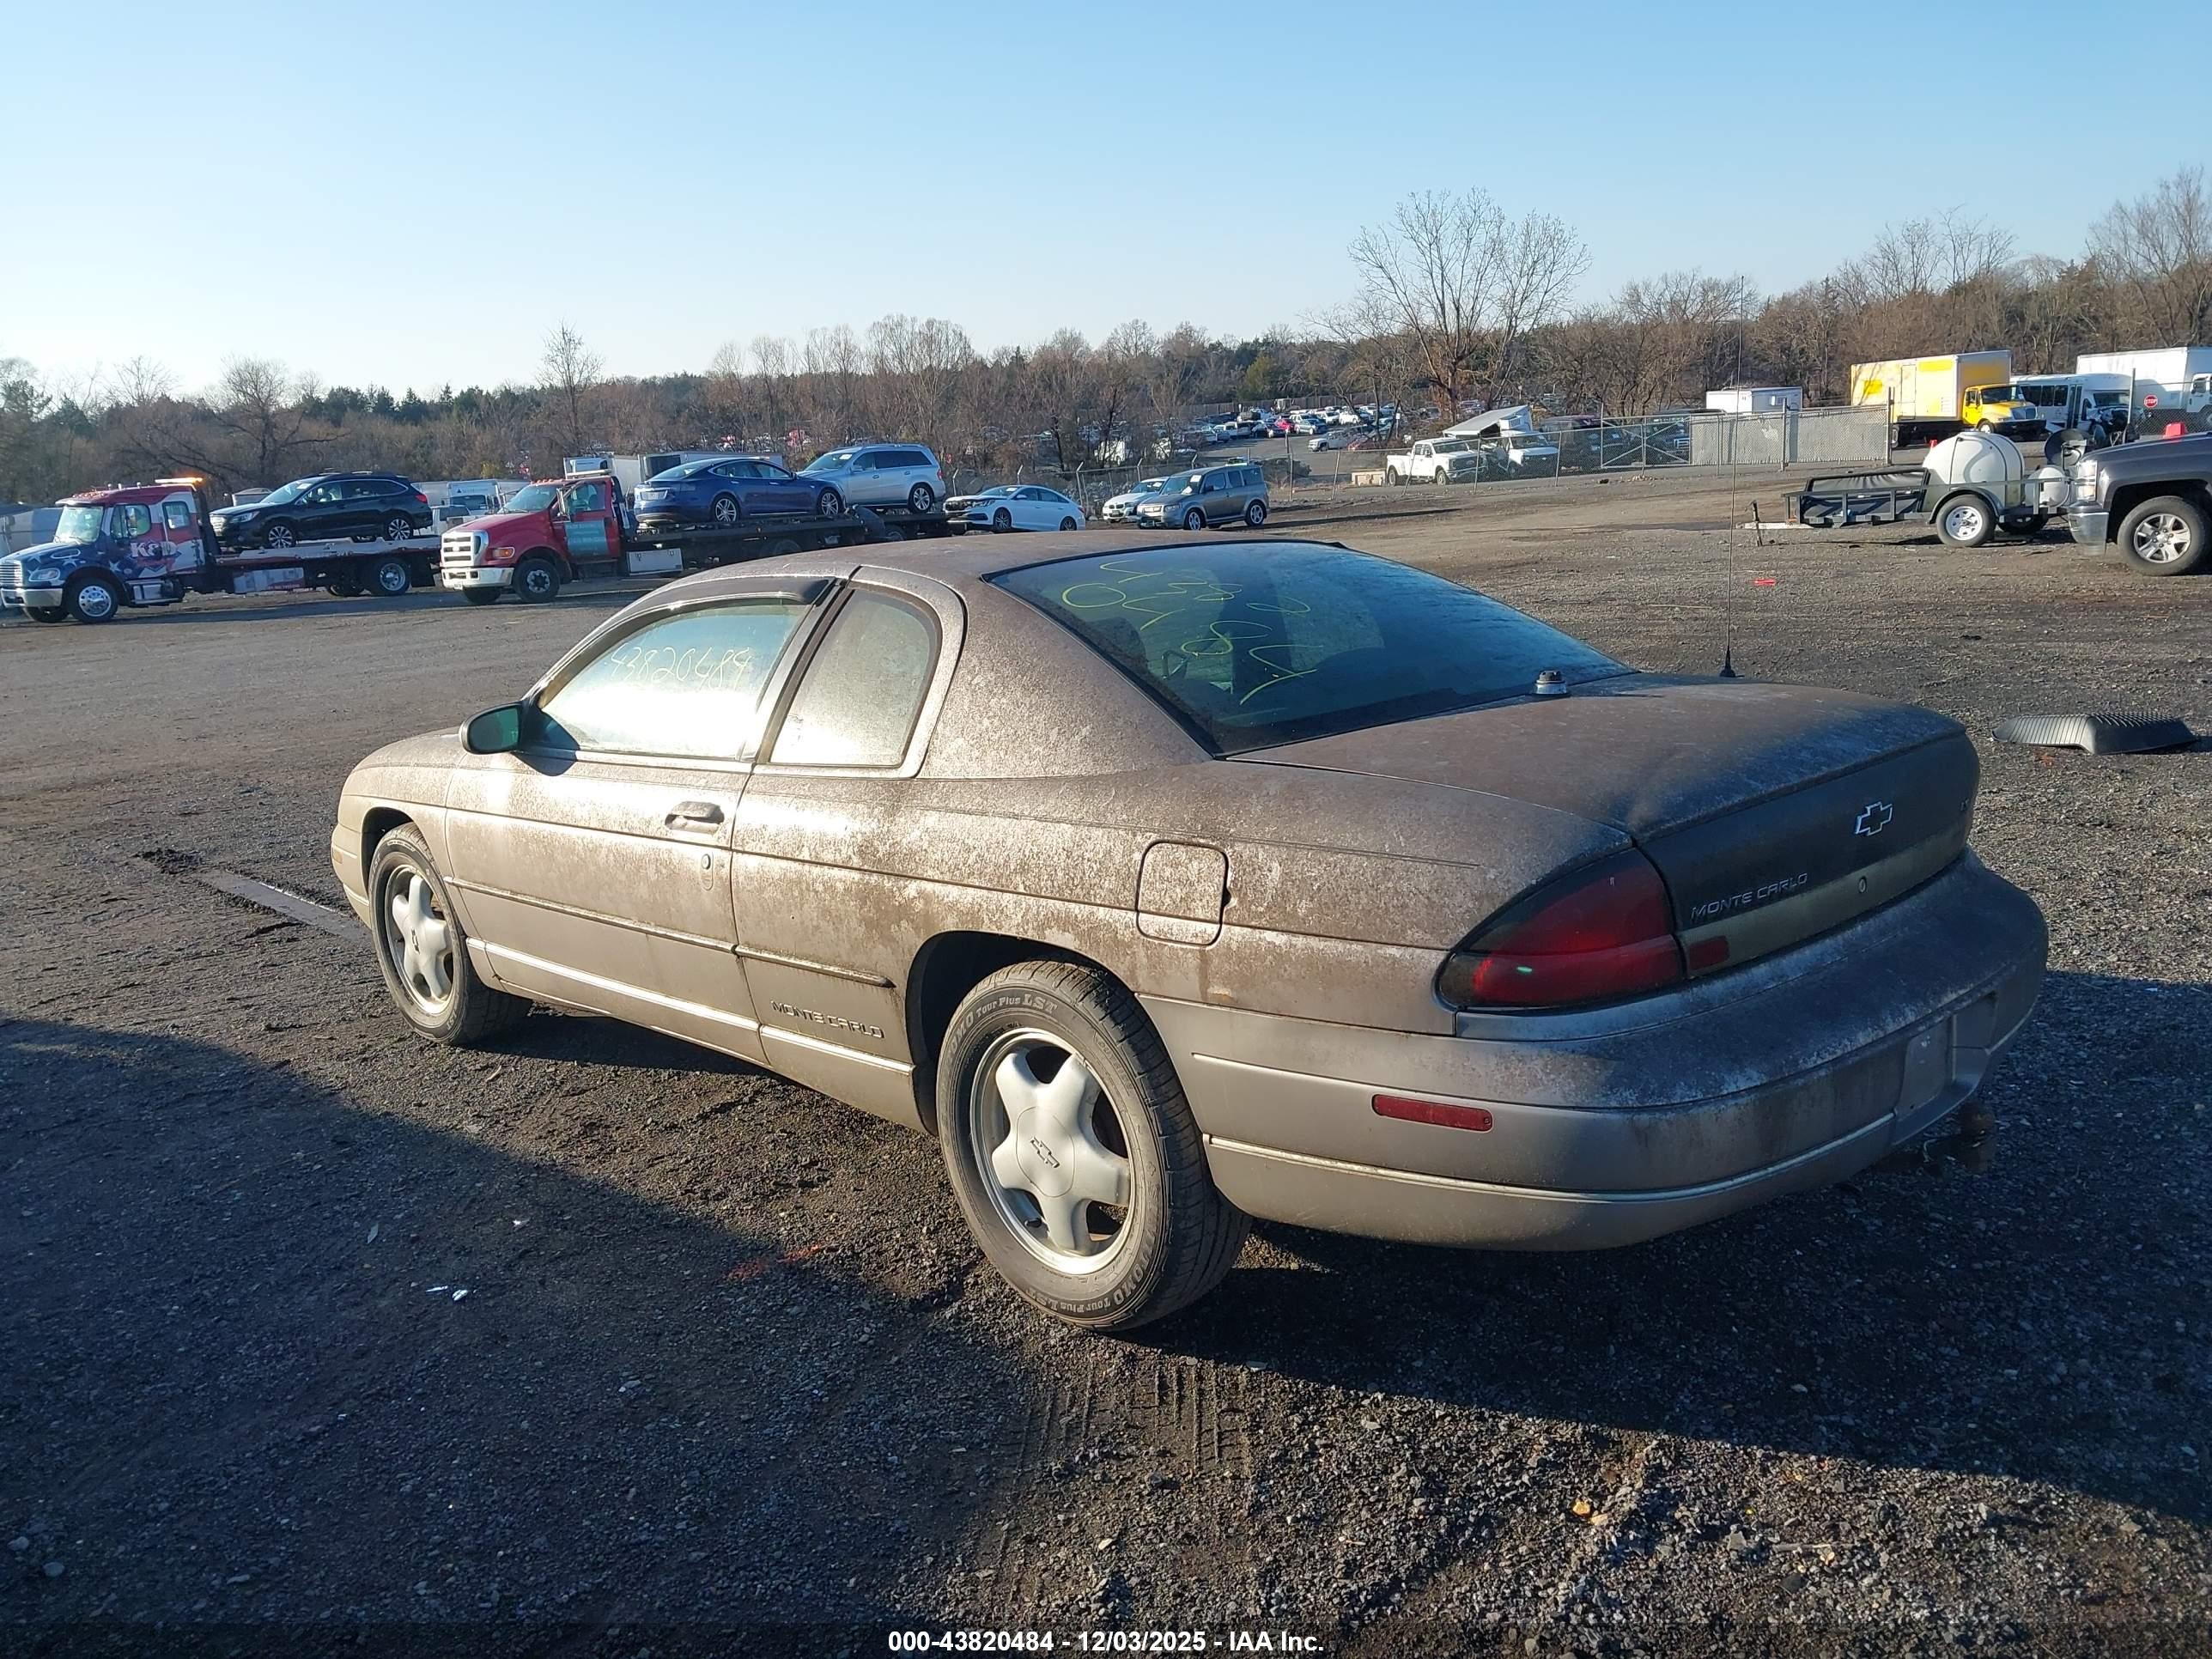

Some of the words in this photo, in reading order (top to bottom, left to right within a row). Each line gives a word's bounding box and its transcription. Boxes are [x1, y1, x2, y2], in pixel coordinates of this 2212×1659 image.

[131, 541, 178, 557] K&D
[611, 643, 752, 690] 43820484
[1691, 891, 1753, 920] MONTE
[1757, 872, 1808, 899] CARLO
[975, 1001, 998, 1018] Tour
[998, 996, 1021, 1007] Plus
[1022, 994, 1058, 1014] LST
[771, 1000, 826, 1024] MONTE
[827, 1015, 885, 1039] CARLO
[1060, 1302, 1085, 1313] Plus
[1085, 1297, 1111, 1312] Tour
